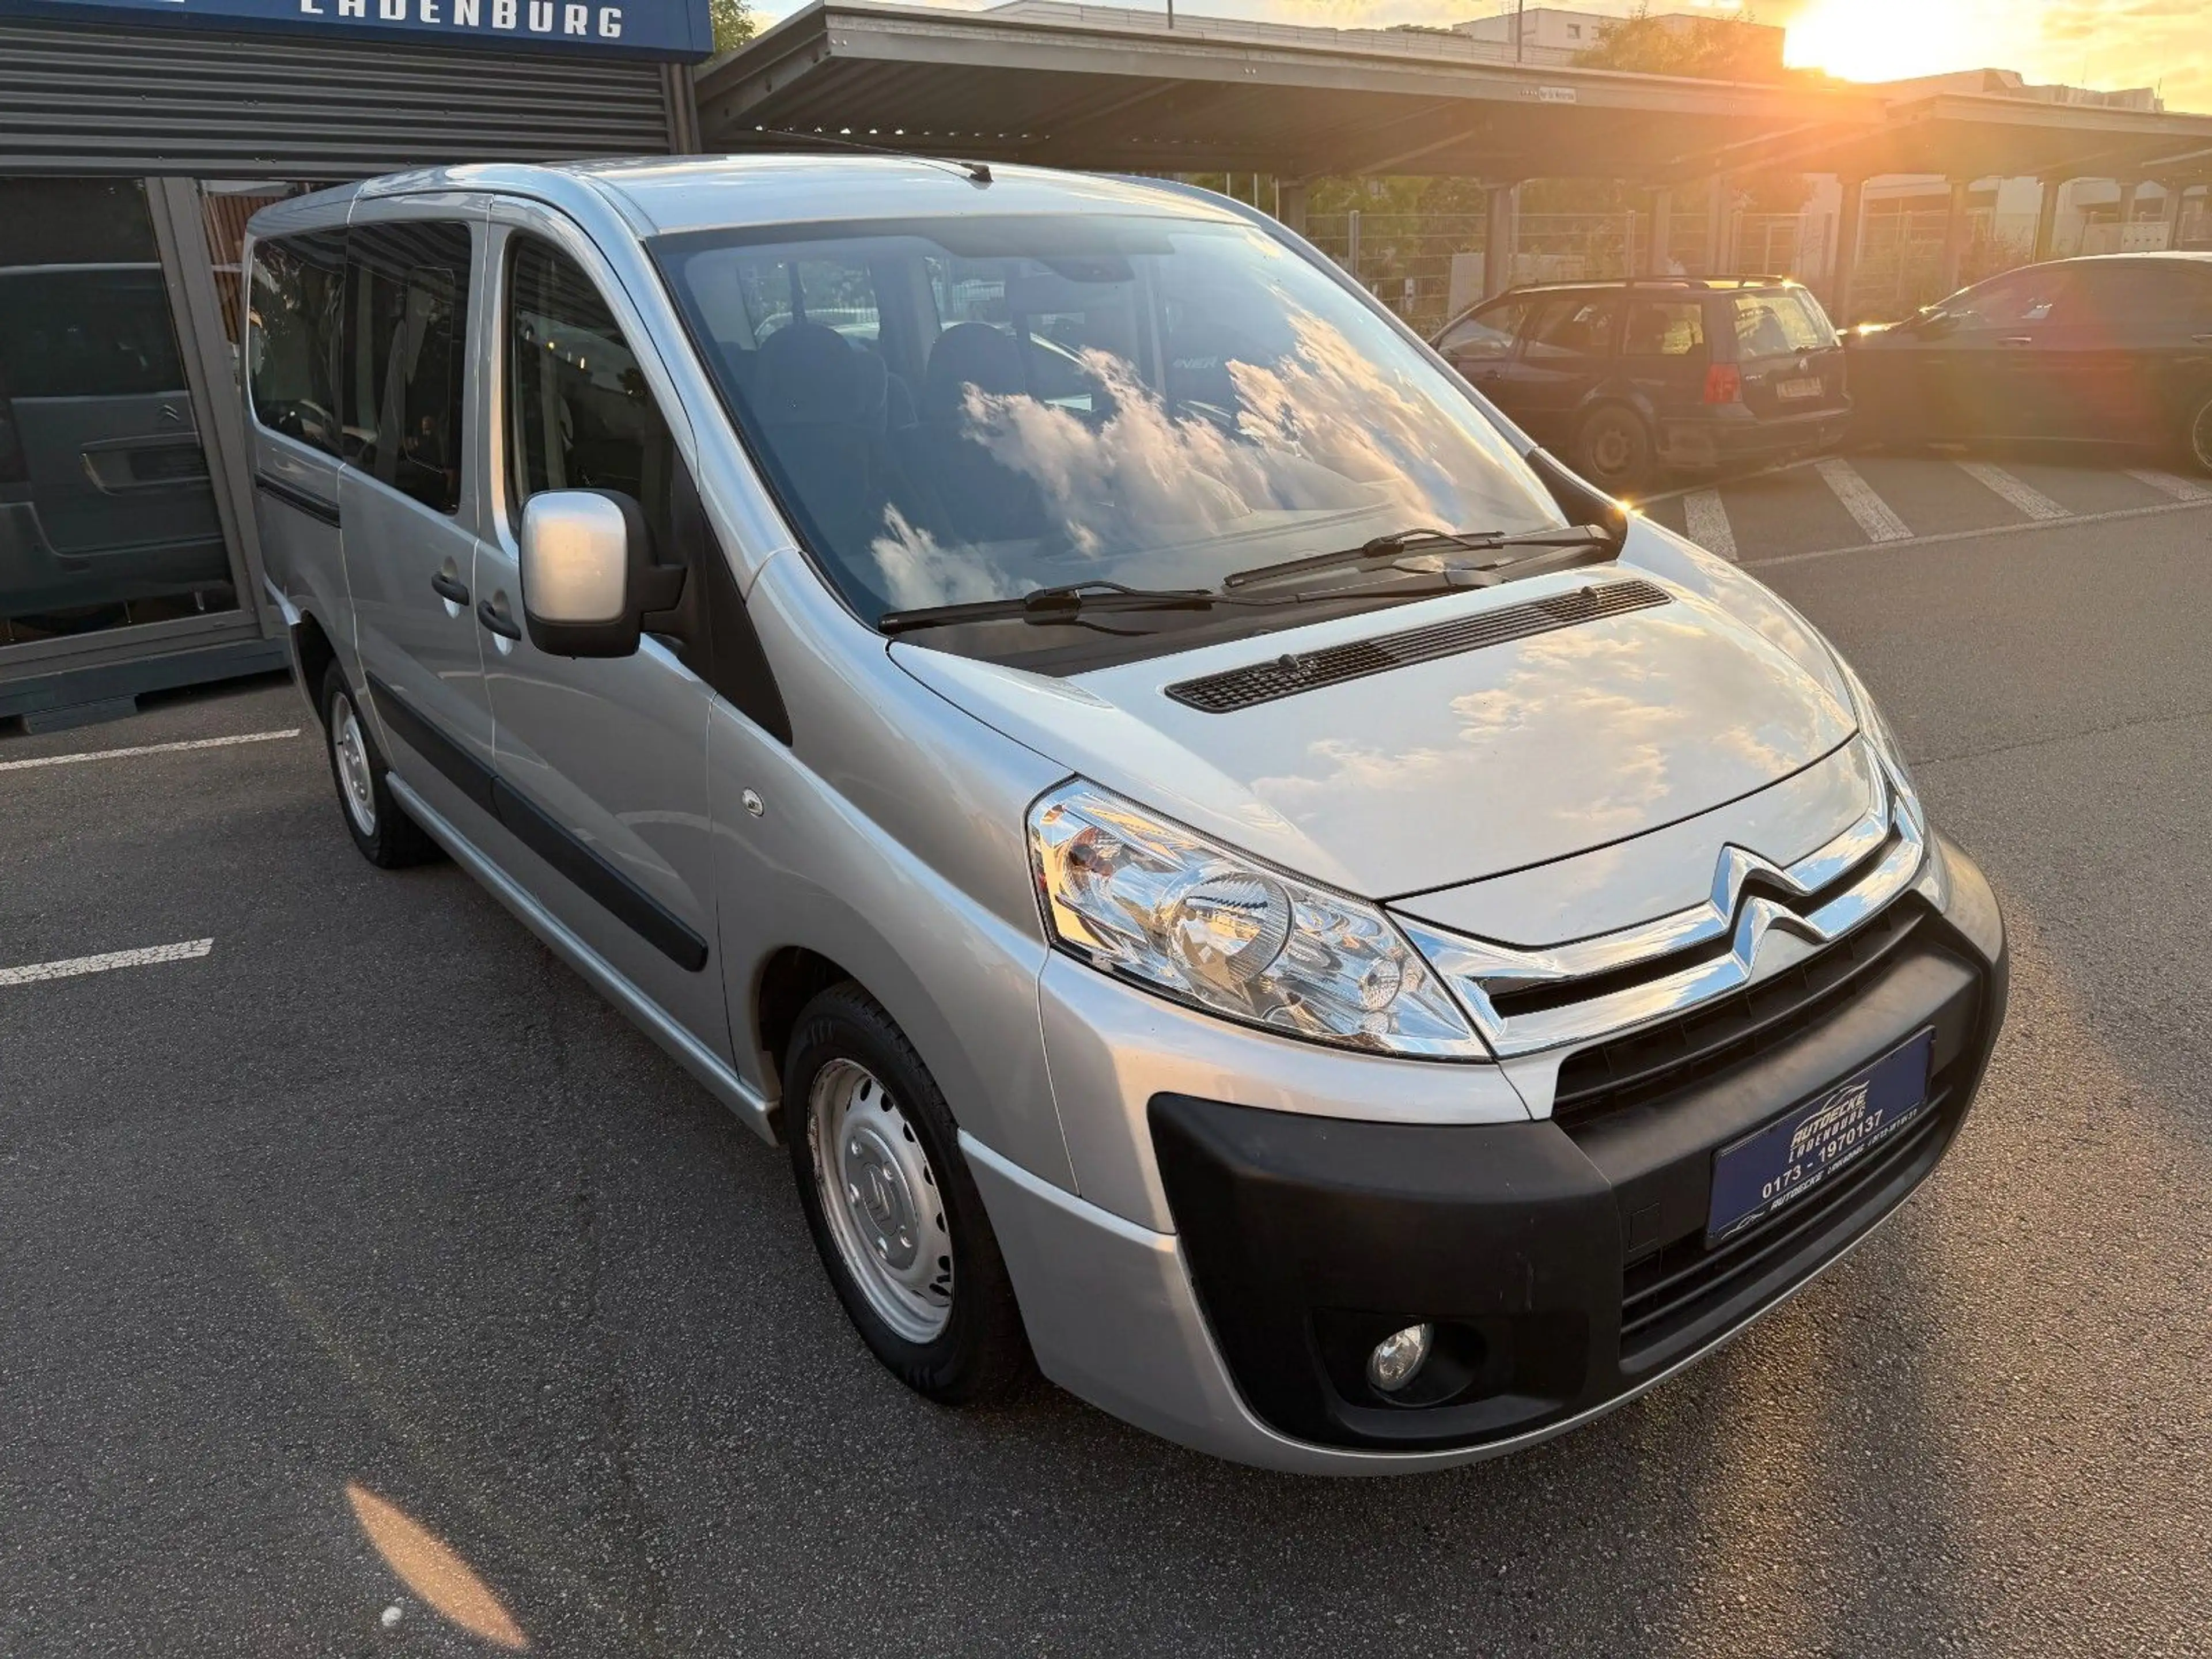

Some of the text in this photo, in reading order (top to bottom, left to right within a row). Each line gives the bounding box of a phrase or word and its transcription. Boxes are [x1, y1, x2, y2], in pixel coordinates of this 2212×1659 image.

[1789, 1108, 1865, 1163] LADENBURG
[1790, 1089, 1869, 1148] AUTOECKE
[1762, 1165, 1801, 1199] 0173
[1819, 1109, 1883, 1162] 1970137
